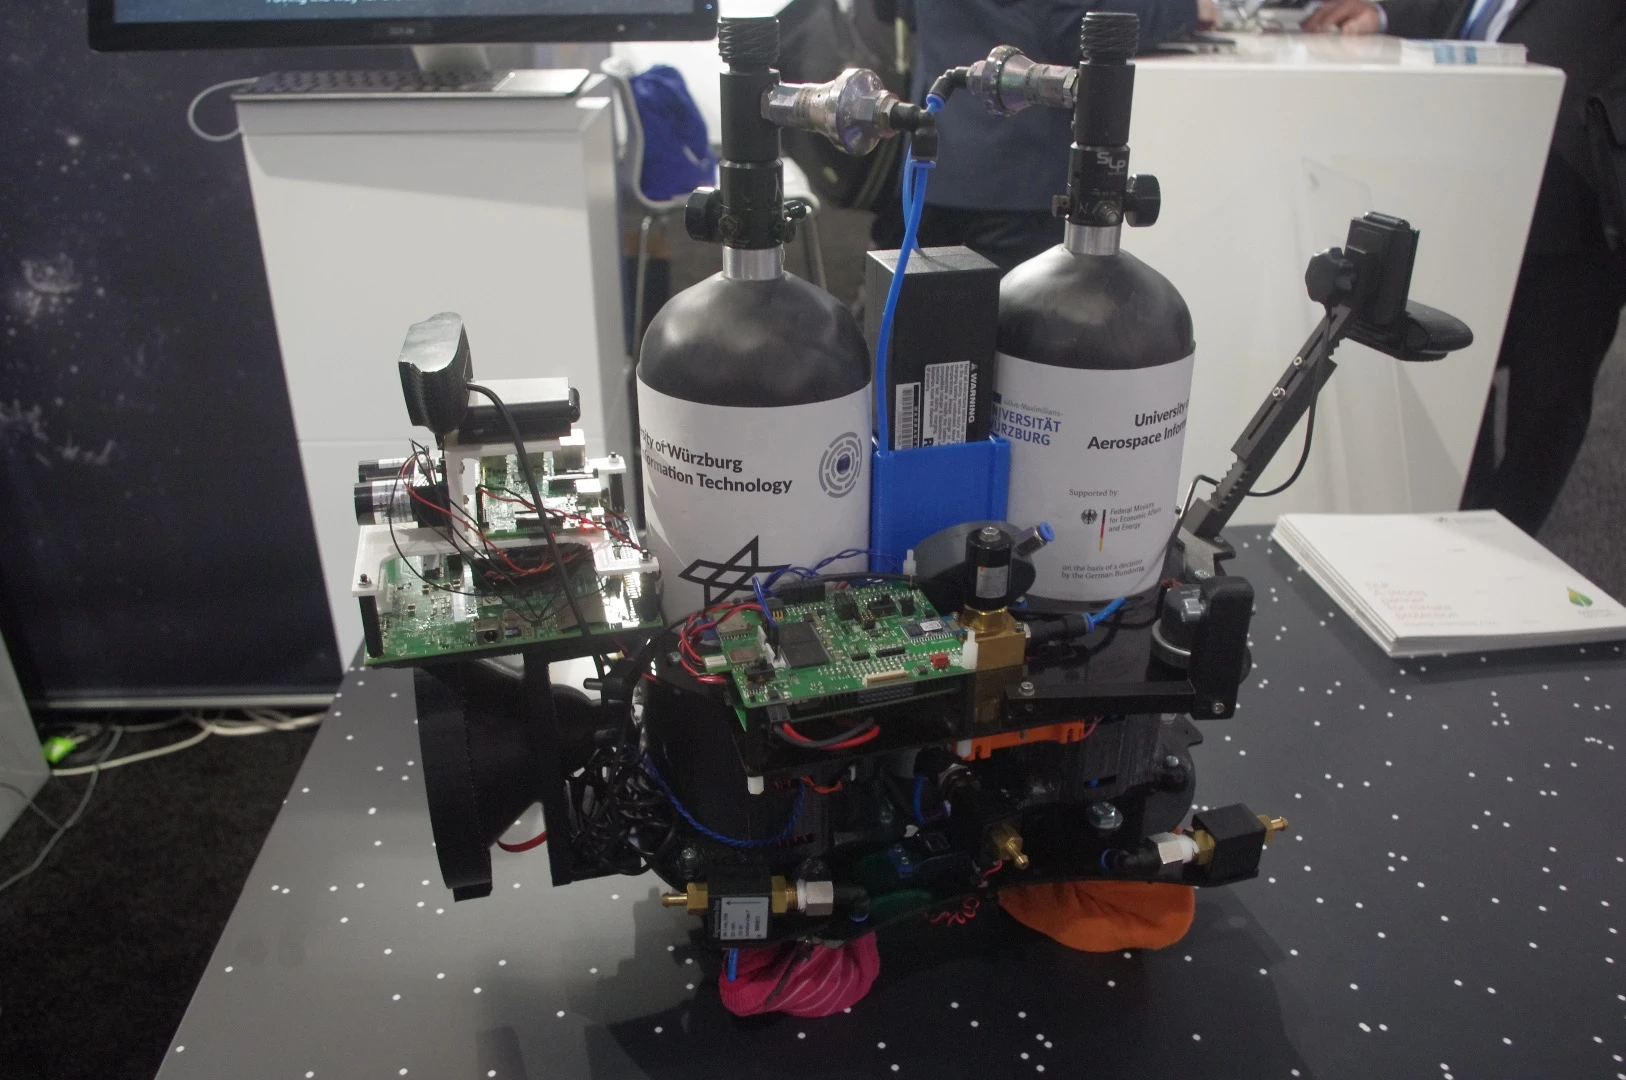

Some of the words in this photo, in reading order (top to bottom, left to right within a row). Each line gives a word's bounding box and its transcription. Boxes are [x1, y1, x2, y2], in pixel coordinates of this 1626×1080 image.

[968, 373, 978, 424] WARNING
[1134, 402, 1185, 427] University
[1087, 432, 1161, 450] Aerospace
[656, 440, 665, 454] of
[667, 443, 743, 473] Würzburg
[696, 472, 793, 495] Technology
[1069, 488, 1108, 498] Supported
[1109, 489, 1120, 498] by:
[1110, 506, 1133, 516] Federal
[1109, 516, 1118, 524] for
[1073, 564, 1085, 572] the
[1086, 564, 1104, 572] basis
[1061, 571, 1070, 580] by
[1085, 571, 1113, 579] German
